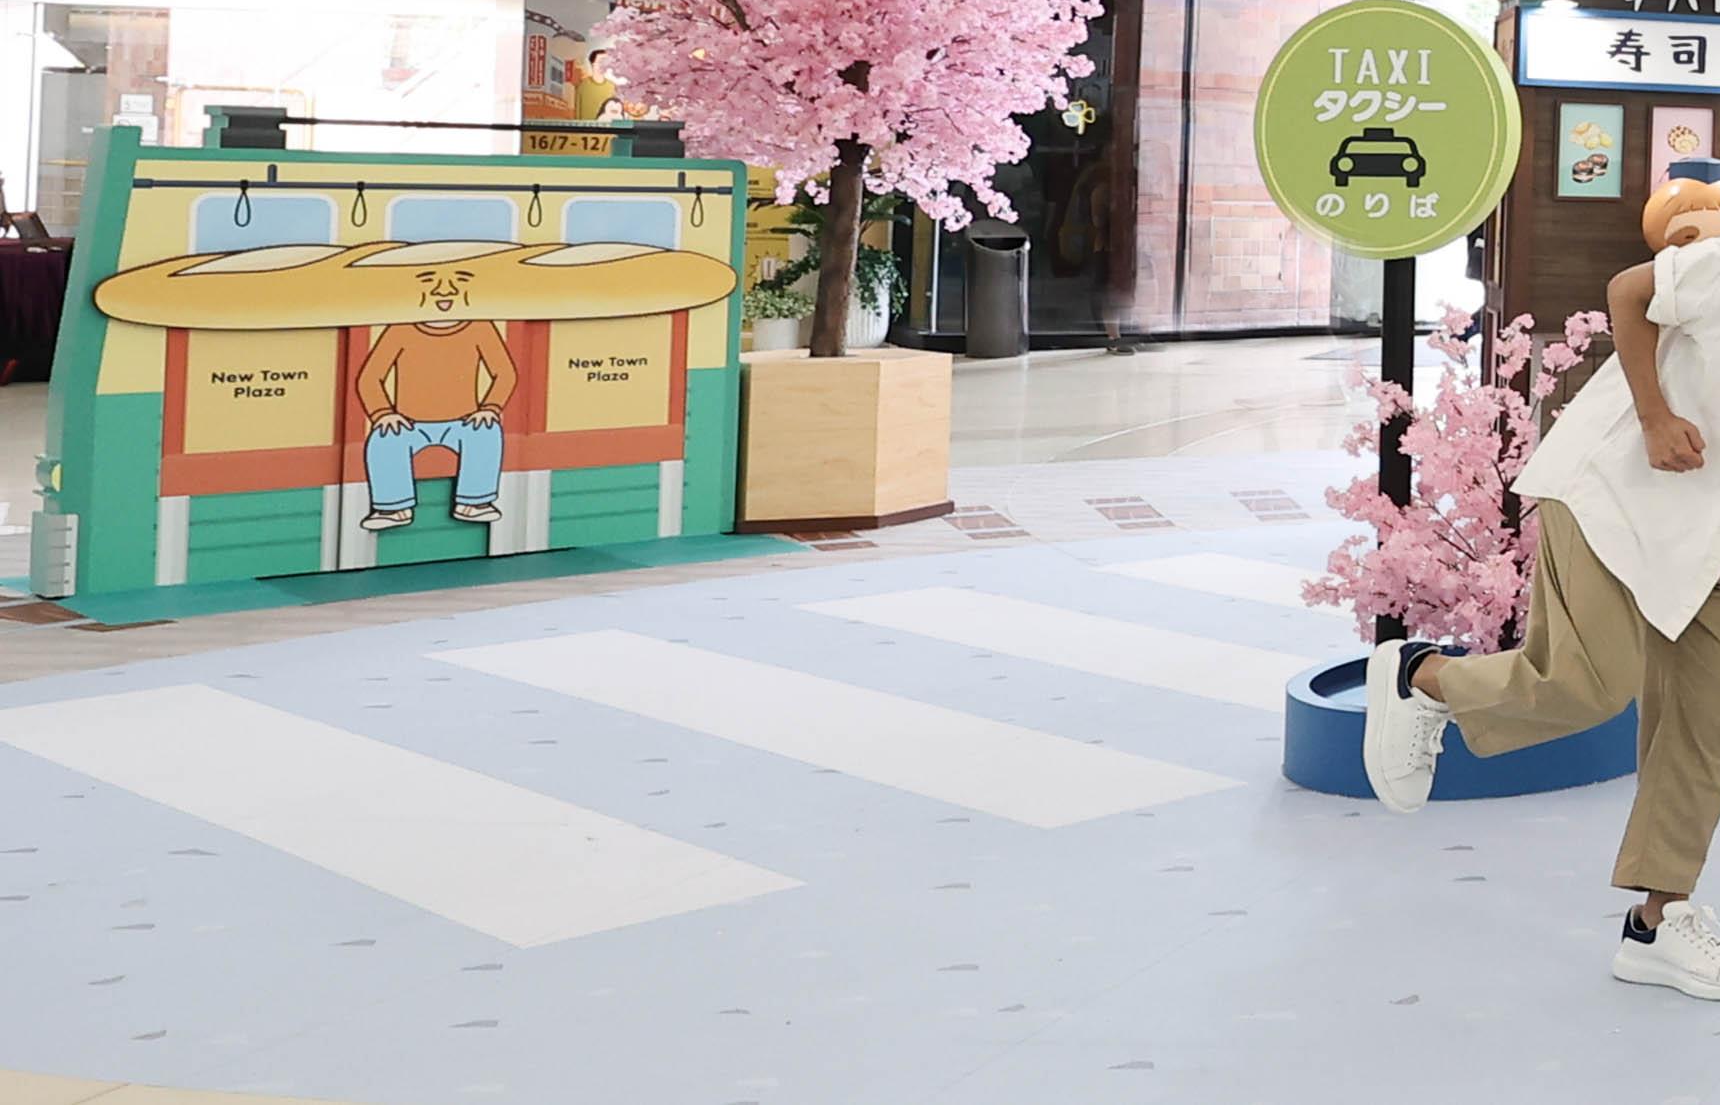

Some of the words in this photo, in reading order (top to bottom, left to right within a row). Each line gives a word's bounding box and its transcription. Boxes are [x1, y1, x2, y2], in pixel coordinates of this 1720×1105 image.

[1327, 48, 1433, 85] TAXI
[1312, 89, 1447, 123] タクシー
[1315, 192, 1440, 219] のりば
[567, 357, 604, 369] New
[609, 356, 648, 367] Town
[210, 371, 254, 384] New
[261, 369, 309, 382] Town
[586, 371, 630, 383] Plaza
[233, 385, 287, 399] Plaza
